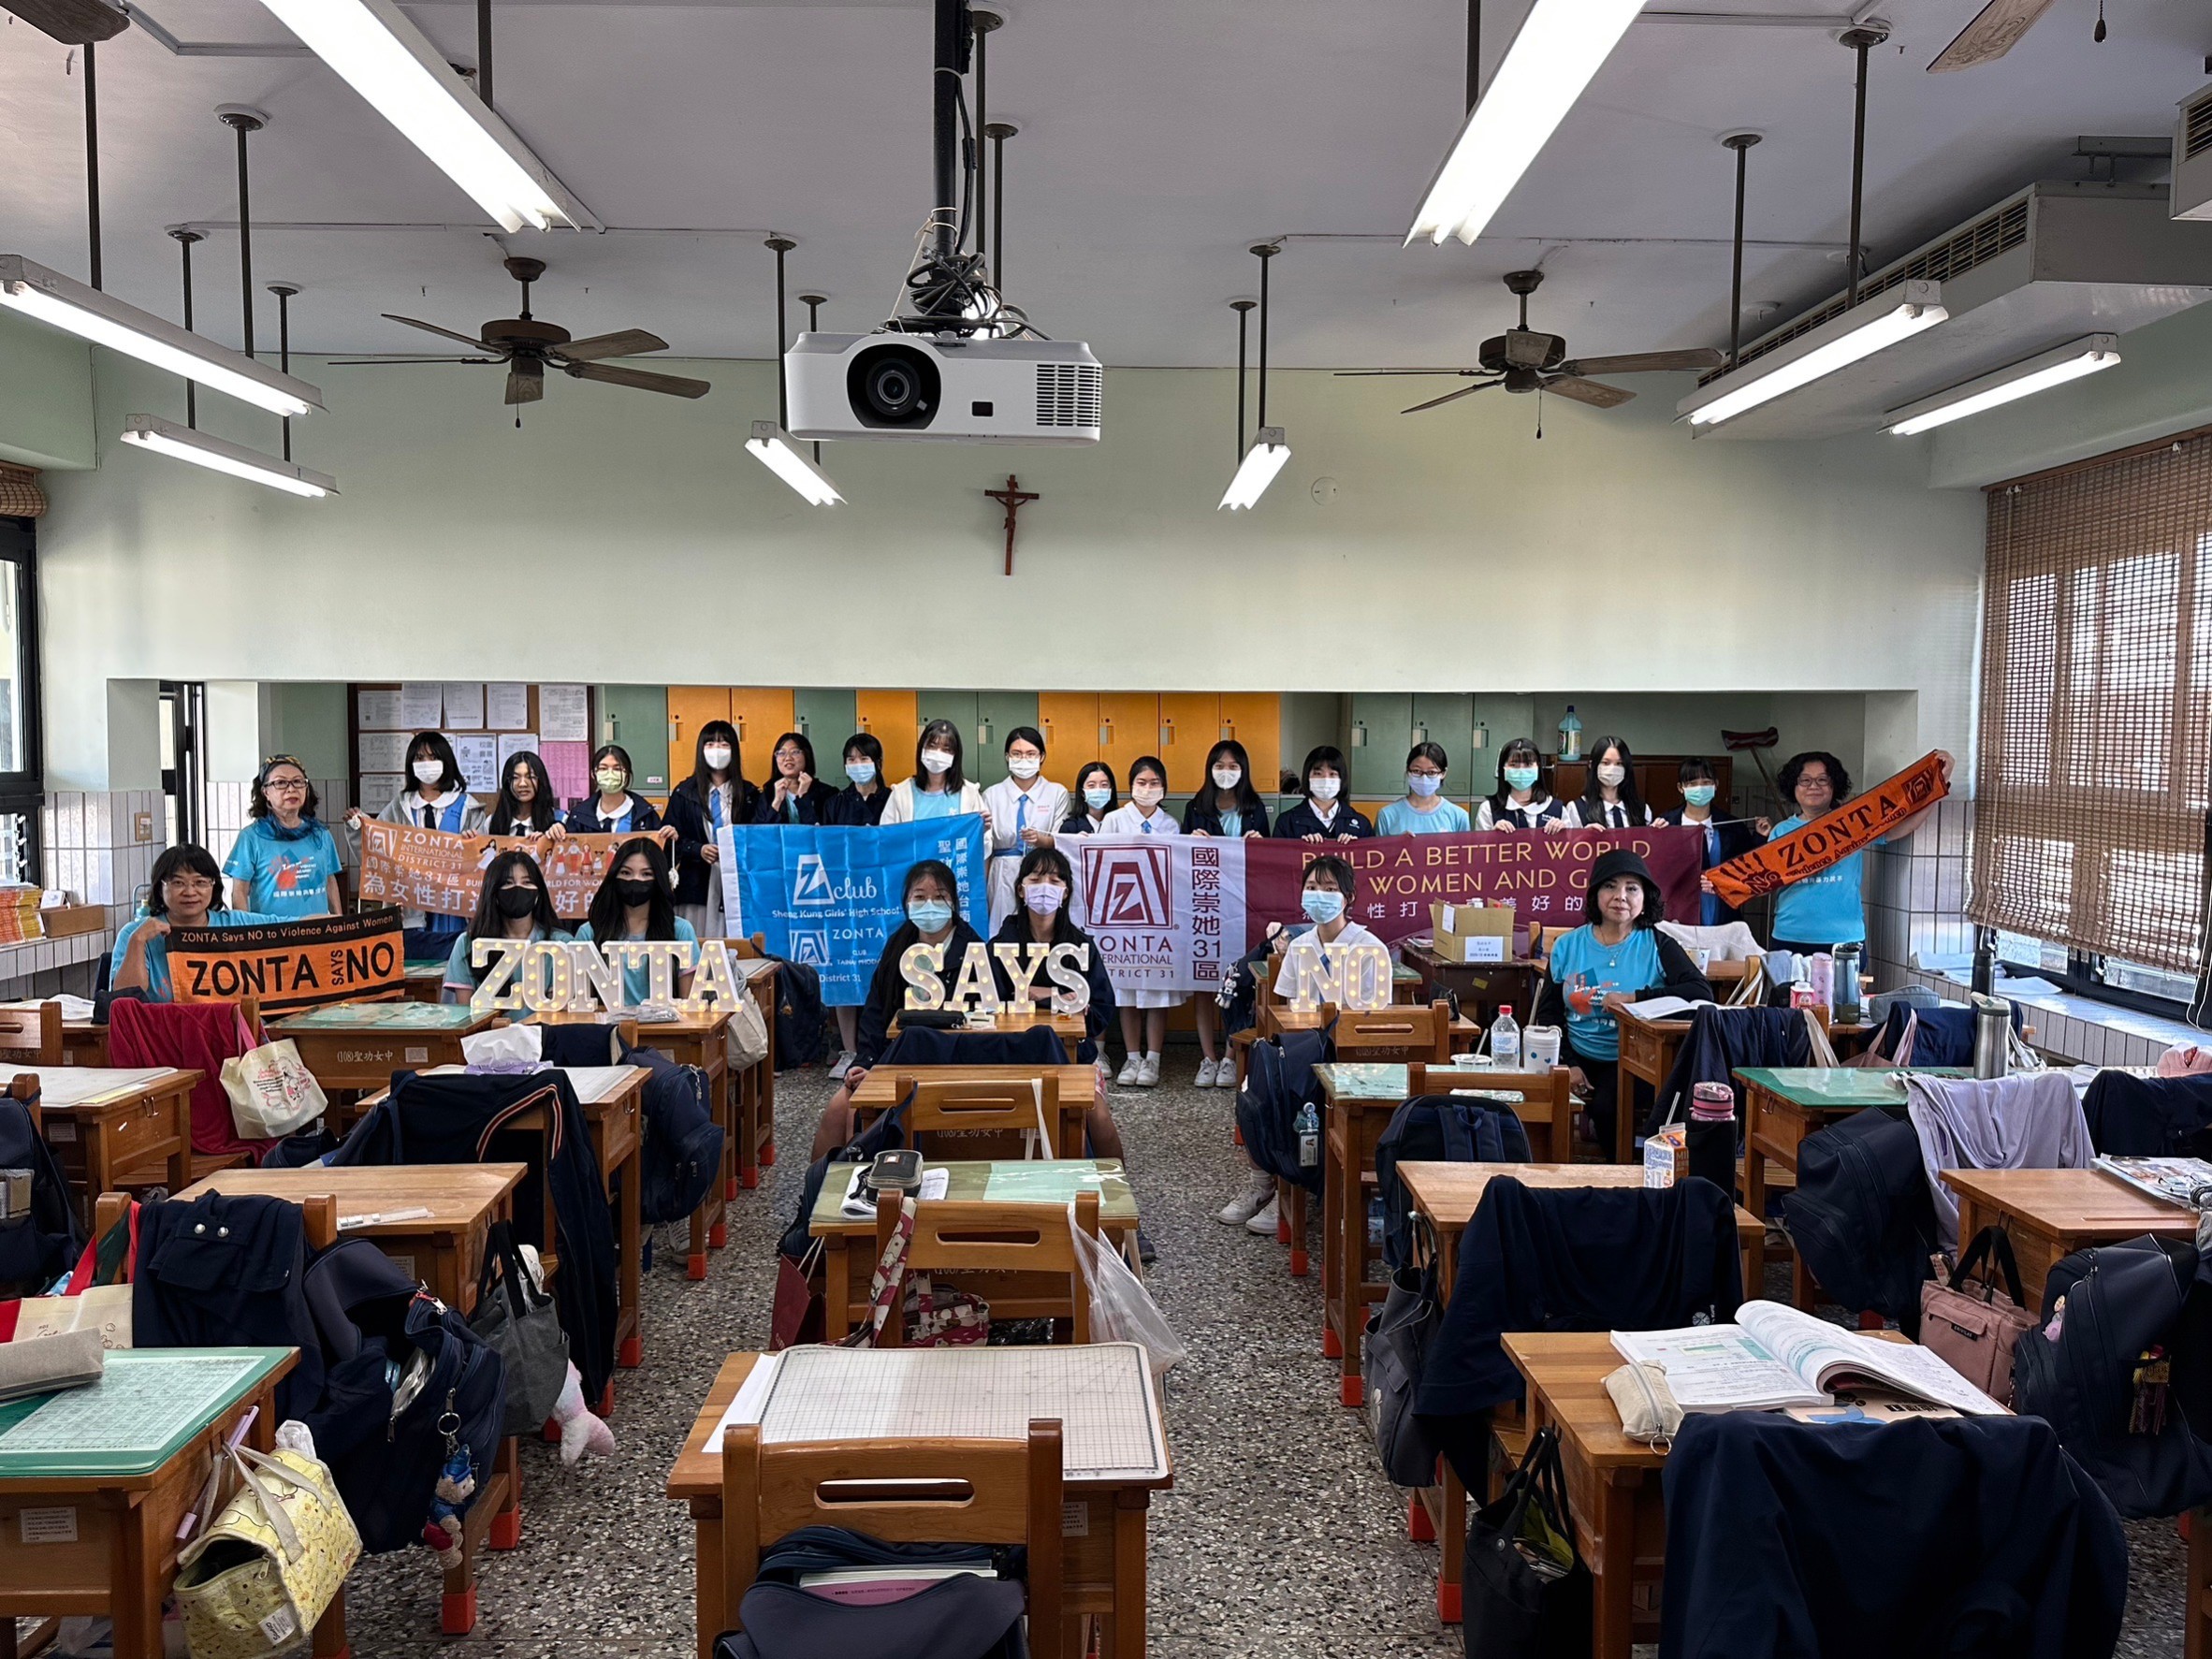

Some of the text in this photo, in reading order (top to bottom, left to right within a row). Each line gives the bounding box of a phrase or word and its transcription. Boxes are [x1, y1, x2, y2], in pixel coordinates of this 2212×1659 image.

[402, 831, 464, 850] ZONTA
[1778, 794, 1898, 868] ZONTA
[398, 854, 462, 870] DISTRICT 31
[400, 844, 463, 859] INTERNATIONAL
[1394, 848, 1414, 867] A
[1426, 842, 1533, 866] BETTER
[833, 877, 878, 900] club
[1369, 872, 1482, 895] WOMEN
[1494, 869, 1556, 890] AND
[772, 910, 798, 919] Sheng
[800, 910, 822, 919] Kung
[850, 908, 868, 918] High
[870, 907, 899, 916] School
[1191, 847, 1221, 981] 國際崇她31區
[182, 915, 393, 942] ZONTA Says NO to Violence Against Women
[833, 927, 884, 940] ZONTA
[1099, 936, 1172, 953] ONTA
[187, 941, 394, 996] ZONTA SAYS NO
[471, 938, 1392, 1013] ZONTA SAYS NO
[819, 974, 861, 982] District 31
[1110, 969, 1174, 979] TRICT 31
